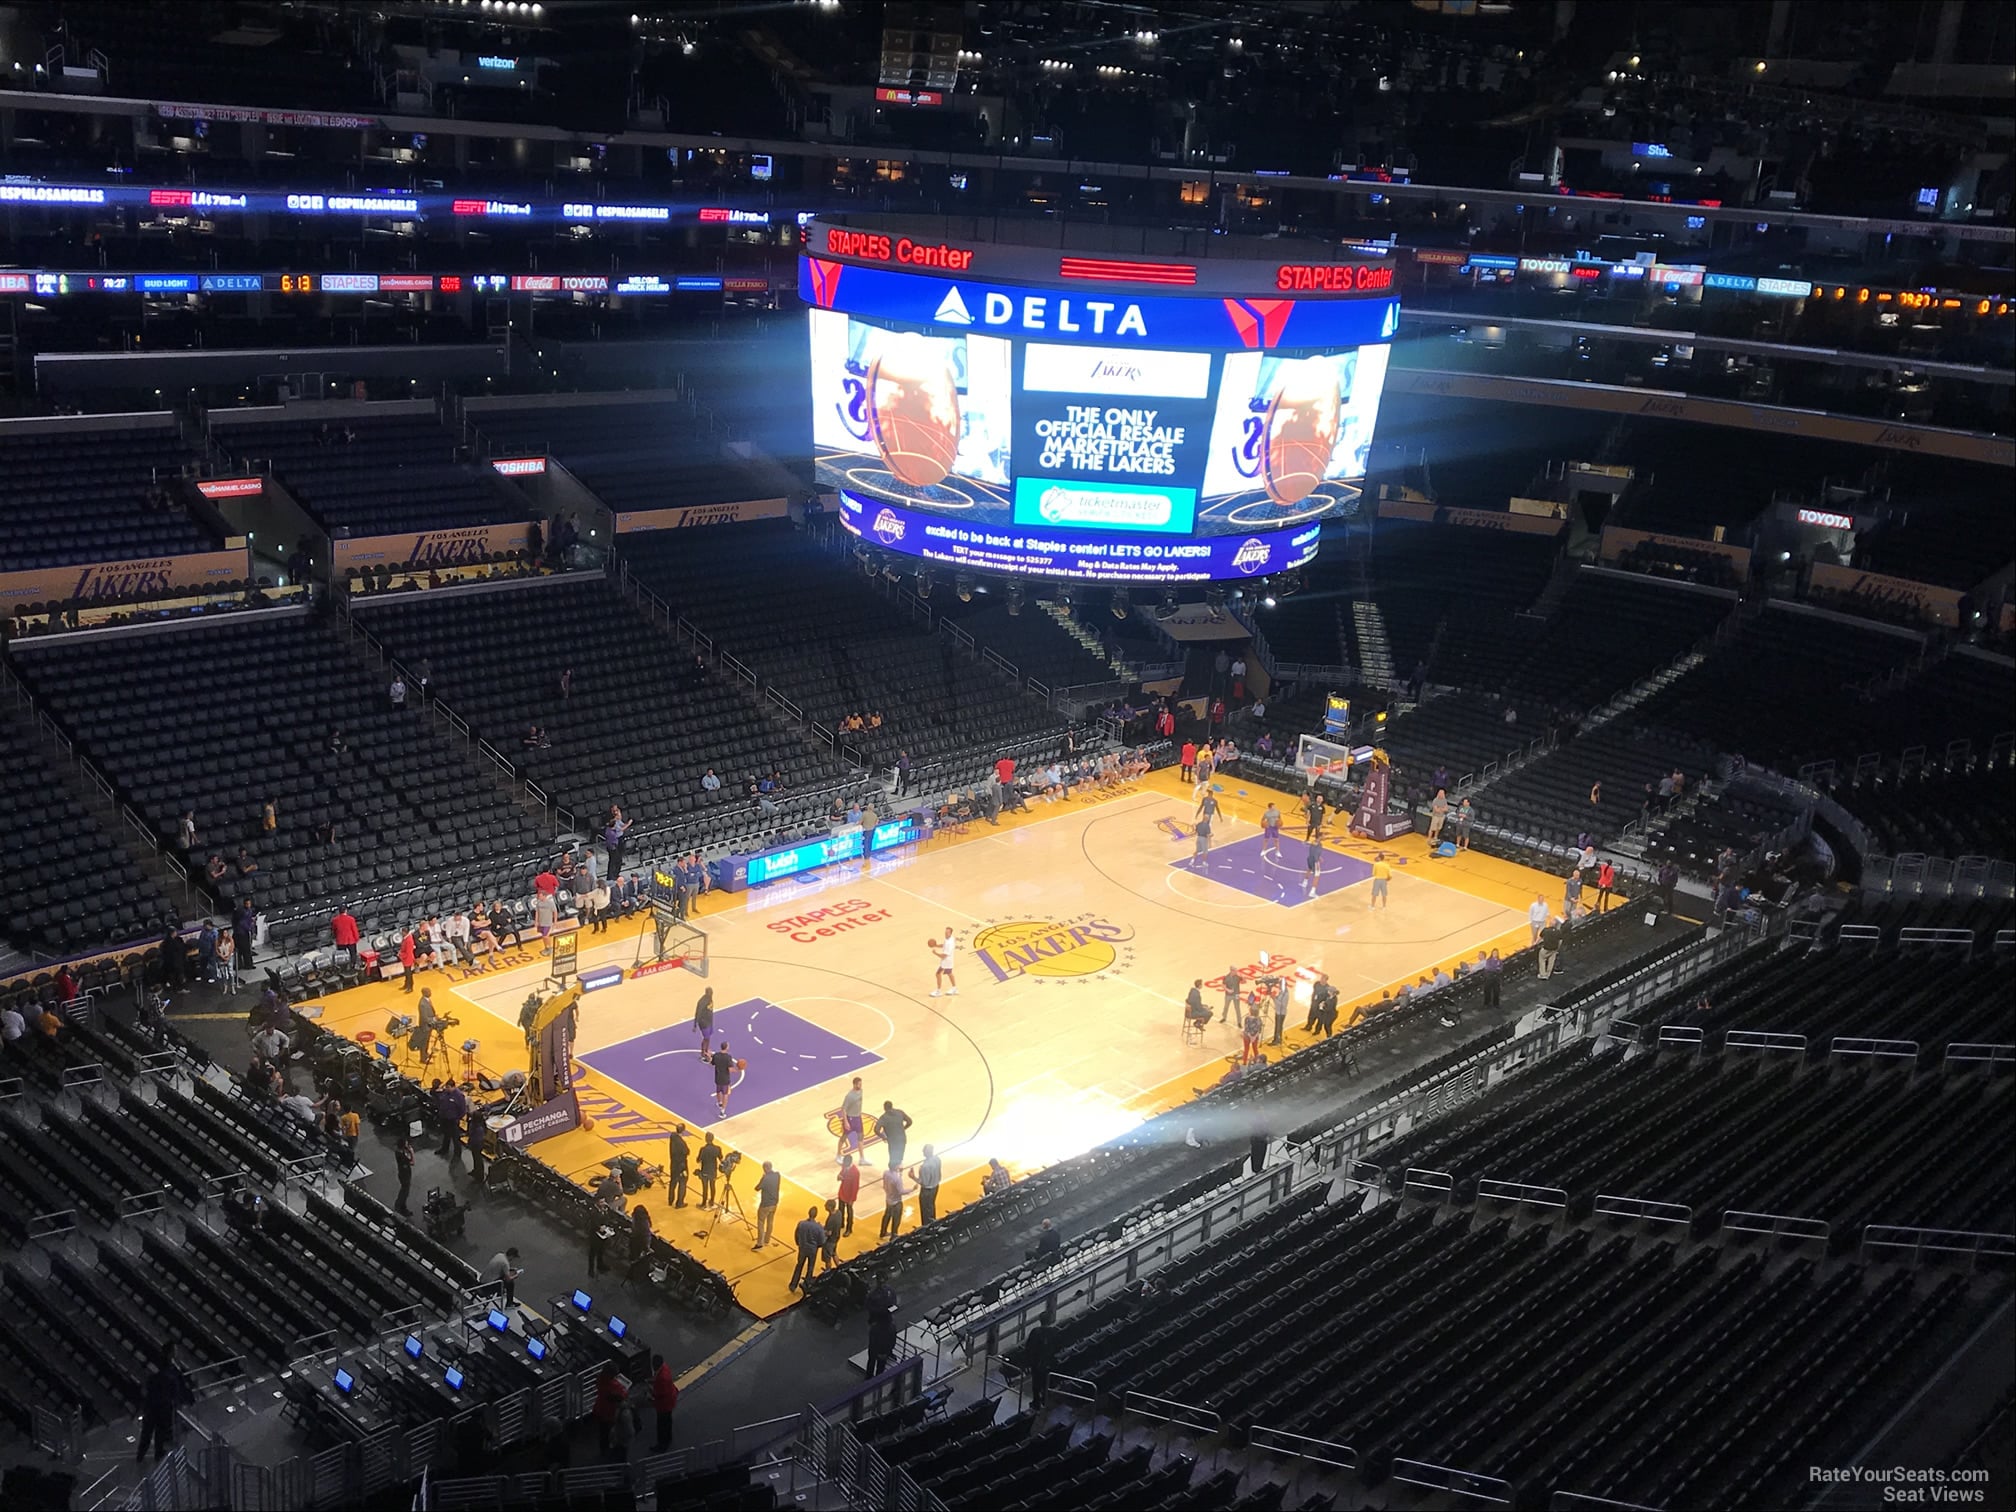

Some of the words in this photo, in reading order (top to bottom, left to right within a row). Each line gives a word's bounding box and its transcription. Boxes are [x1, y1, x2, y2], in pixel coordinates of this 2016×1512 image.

[478, 55, 515, 69] verizon
[150, 190, 192, 204] ESPN
[453, 200, 487, 212] ESPN
[700, 208, 729, 220] ESPN
[828, 228, 891, 261] STAPLES
[896, 237, 974, 271] Center
[1522, 259, 1570, 272] TOYOTA
[144, 279, 162, 288] BUD
[163, 279, 188, 288] LIGHT
[217, 278, 260, 288] DELTA
[281, 275, 311, 291] 6:13
[322, 276, 376, 289] STAPLES
[562, 277, 608, 289] TOYOTA
[1276, 264, 1353, 291] STAPLES
[1356, 264, 1393, 289] Center
[1718, 277, 1755, 288] DELTA
[1759, 279, 1809, 294] STAPLES
[984, 292, 1148, 336] DELTA
[1066, 406, 1100, 424] THE
[1105, 408, 1158, 427] ONLY
[1035, 420, 1115, 440] OFFICIAL
[1120, 426, 1185, 444] RESALE
[1044, 437, 1173, 459] MARKETPLACE
[1039, 452, 1065, 468] OF
[1071, 453, 1103, 471] THE
[1108, 457, 1175, 475] LAKERS
[1080, 496, 1161, 510] ticketmaster
[873, 514, 905, 539] LAKERS
[1799, 509, 1852, 530] TOYOTA
[430, 532, 448, 540] LOS
[449, 528, 489, 539] ANGELES
[925, 525, 957, 540] excited
[958, 529, 968, 541] to
[970, 531, 984, 544] be
[986, 534, 1011, 547] back
[1013, 538, 1024, 549] at
[1026, 539, 1066, 554] Staples
[1110, 545, 1141, 557] LETS
[1143, 546, 1162, 557] GO
[1164, 546, 1211, 558] LAKERS!
[409, 534, 489, 563] LAKERS
[923, 548, 934, 558] The
[953, 545, 968, 555] TEXT
[1017, 555, 1025, 563] to
[1231, 547, 1270, 566] LAKERS
[99, 564, 120, 573] LOS
[122, 559, 173, 571] ANGELES
[71, 567, 172, 599] LAKERS
[764, 850, 799, 871] wish
[766, 899, 872, 935] STAPLES
[790, 907, 893, 945] Center
[997, 935, 1026, 949] LOS
[1030, 912, 1096, 939] ANGELES
[969, 919, 1135, 984] LAKERS
[561, 1027, 570, 1085] PECHANGA.COM
[522, 1109, 568, 1131] PECHANGA
[524, 1124, 546, 1136] RESORT
